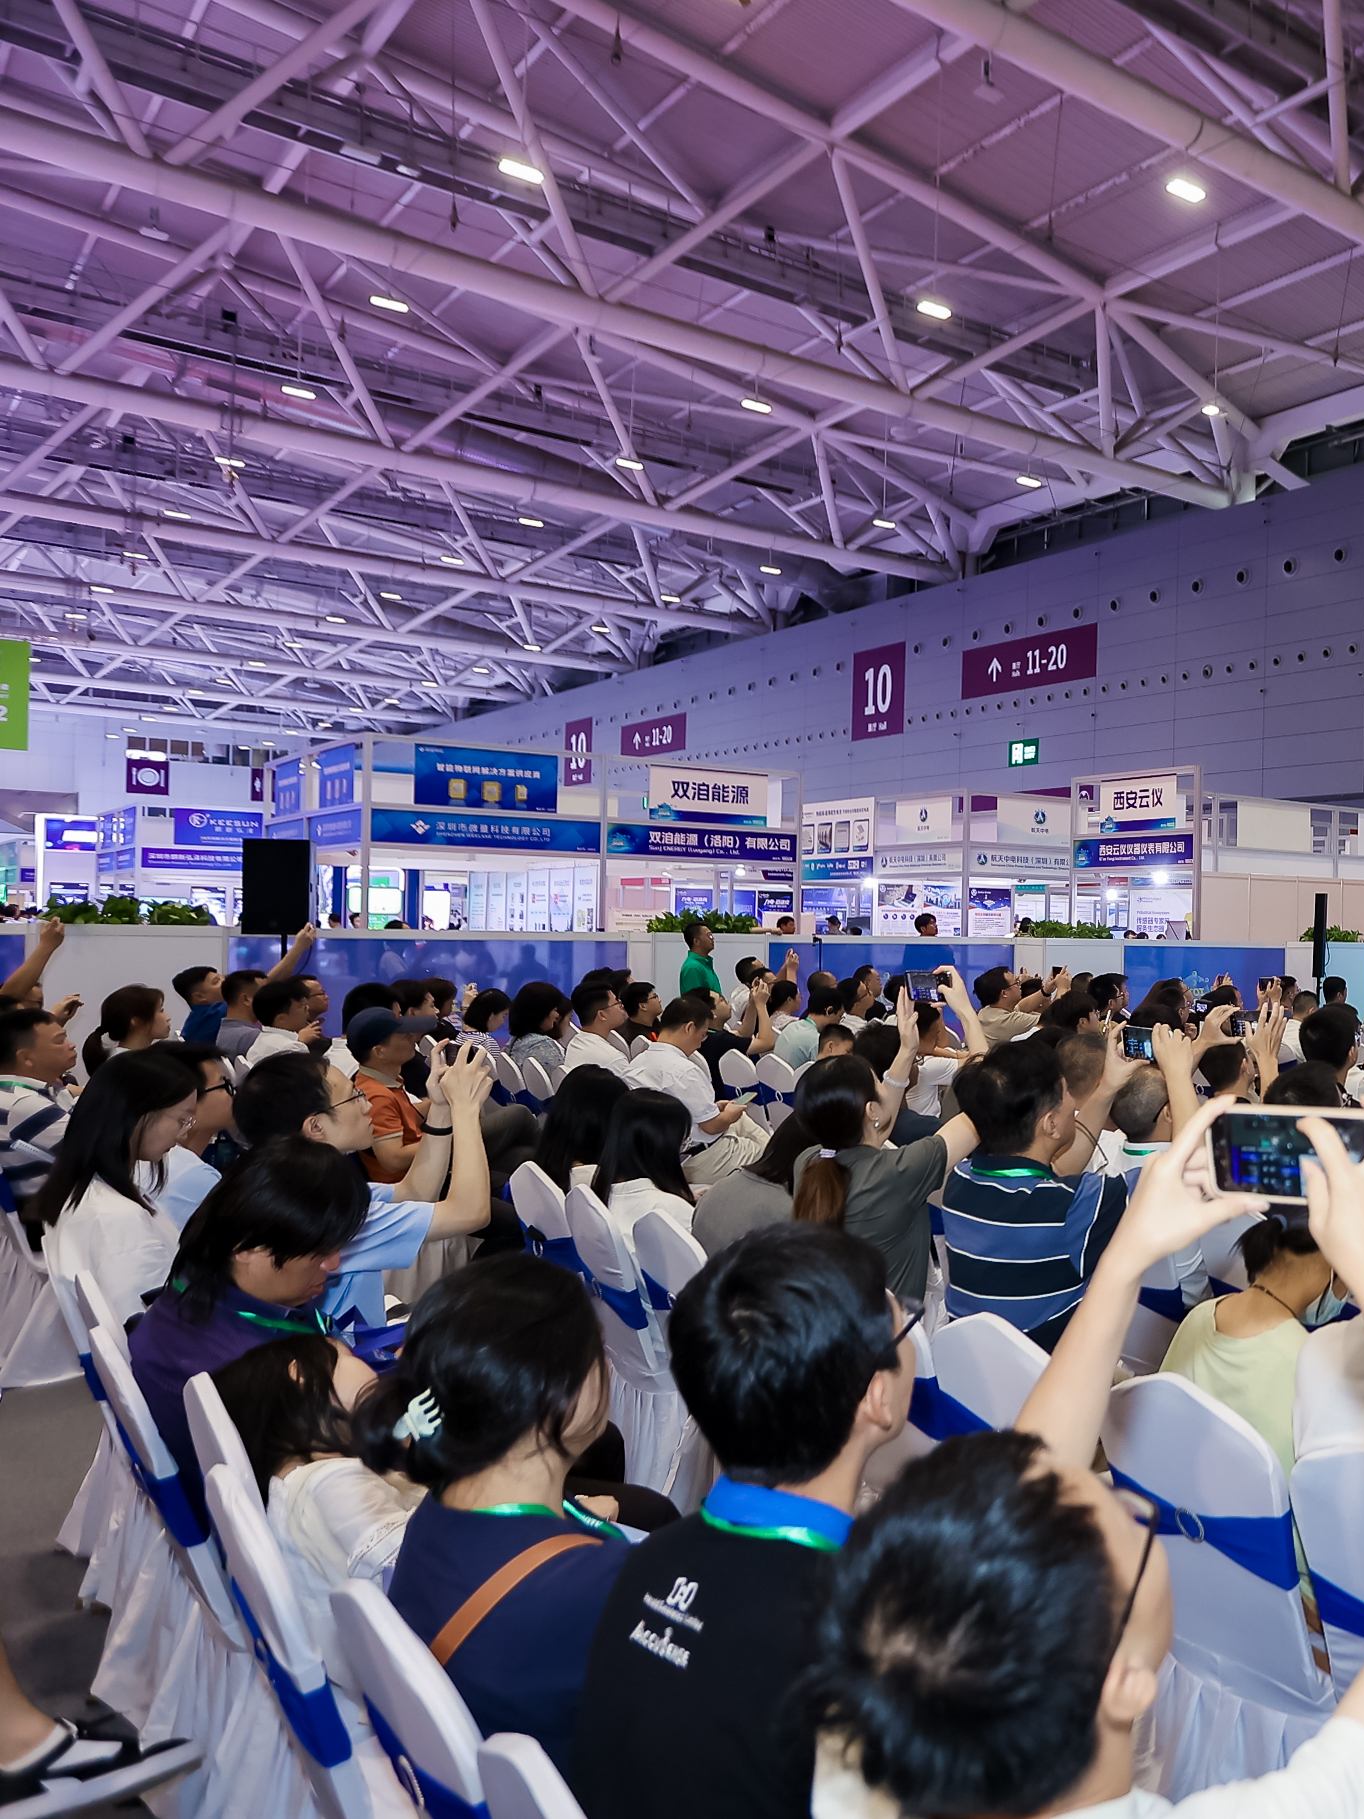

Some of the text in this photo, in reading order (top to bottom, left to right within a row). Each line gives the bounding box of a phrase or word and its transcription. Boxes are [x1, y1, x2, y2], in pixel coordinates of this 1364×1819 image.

[1026, 643, 1067, 675] 11-20
[864, 664, 892, 716] 10
[651, 724, 673, 746] 11-20
[570, 731, 587, 770] 10
[1113, 788, 1163, 811] 西安云仪
[1098, 841, 1185, 857] 西安云仪仪器仪表有限公司
